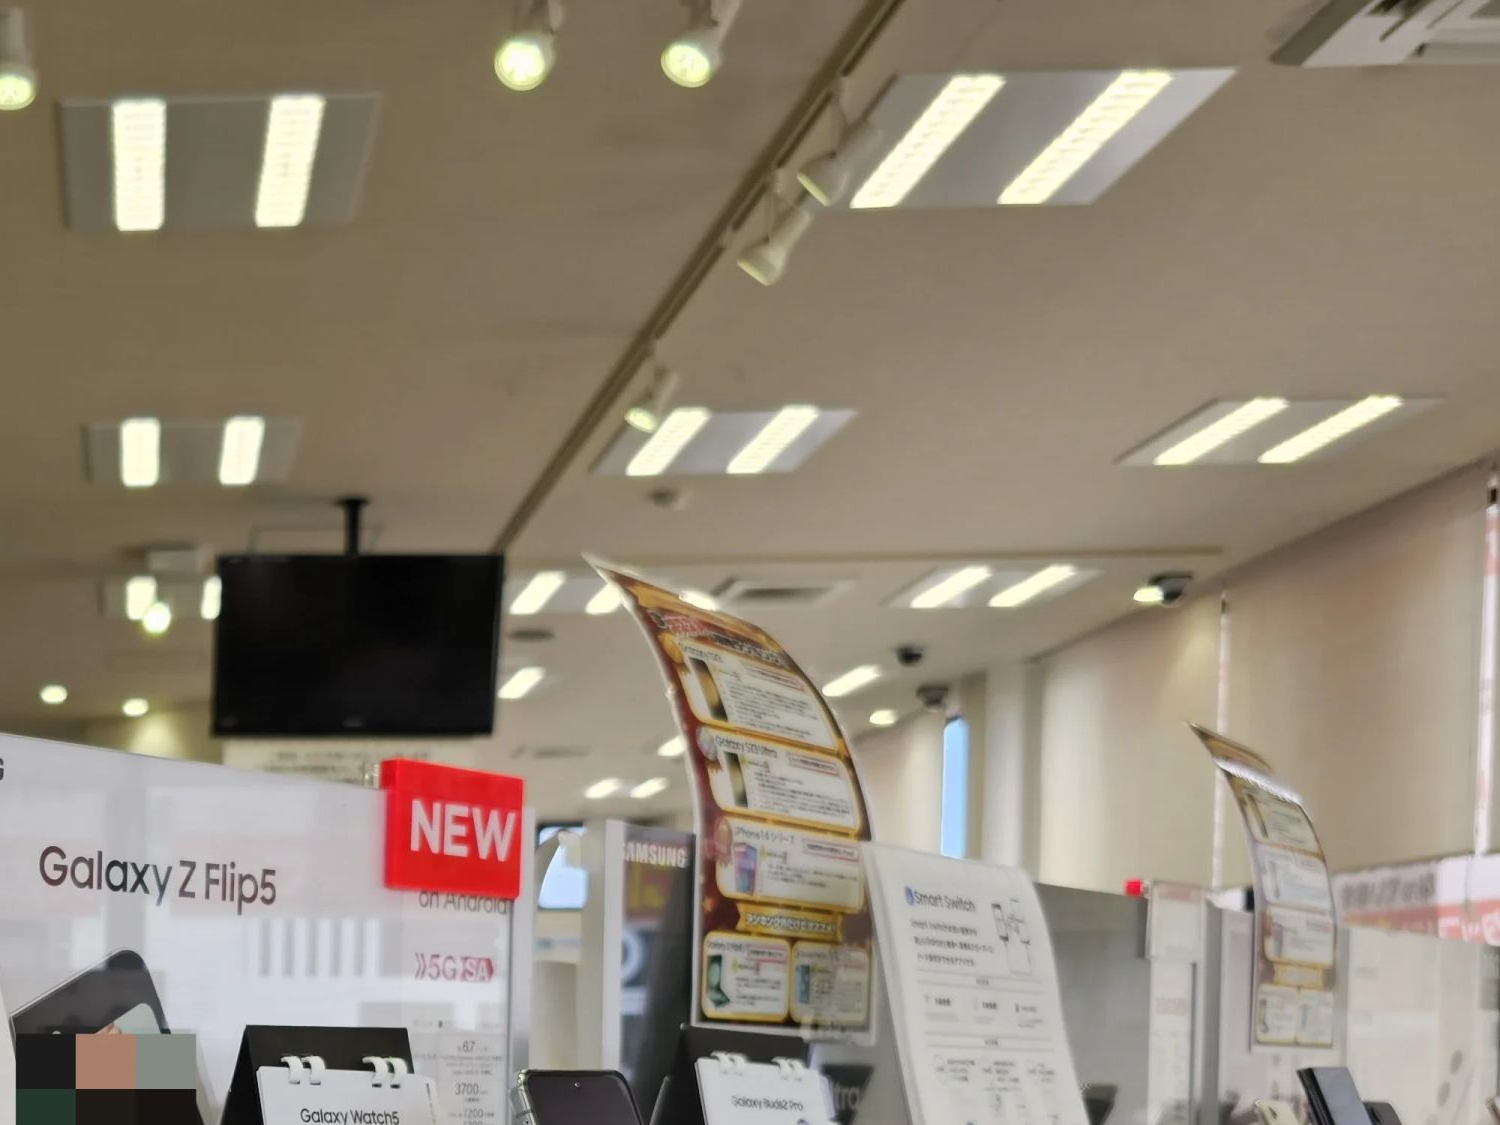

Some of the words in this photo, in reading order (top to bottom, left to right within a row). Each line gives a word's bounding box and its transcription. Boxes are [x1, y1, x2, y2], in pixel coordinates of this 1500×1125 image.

[410, 799, 516, 862] NEW
[625, 842, 687, 868] AMSUNG
[39, 846, 172, 905] Galaxy
[178, 860, 197, 898] Z
[205, 861, 277, 915] Flip5
[443, 892, 507, 914] Android
[349, 1110, 400, 1125] Watch5
